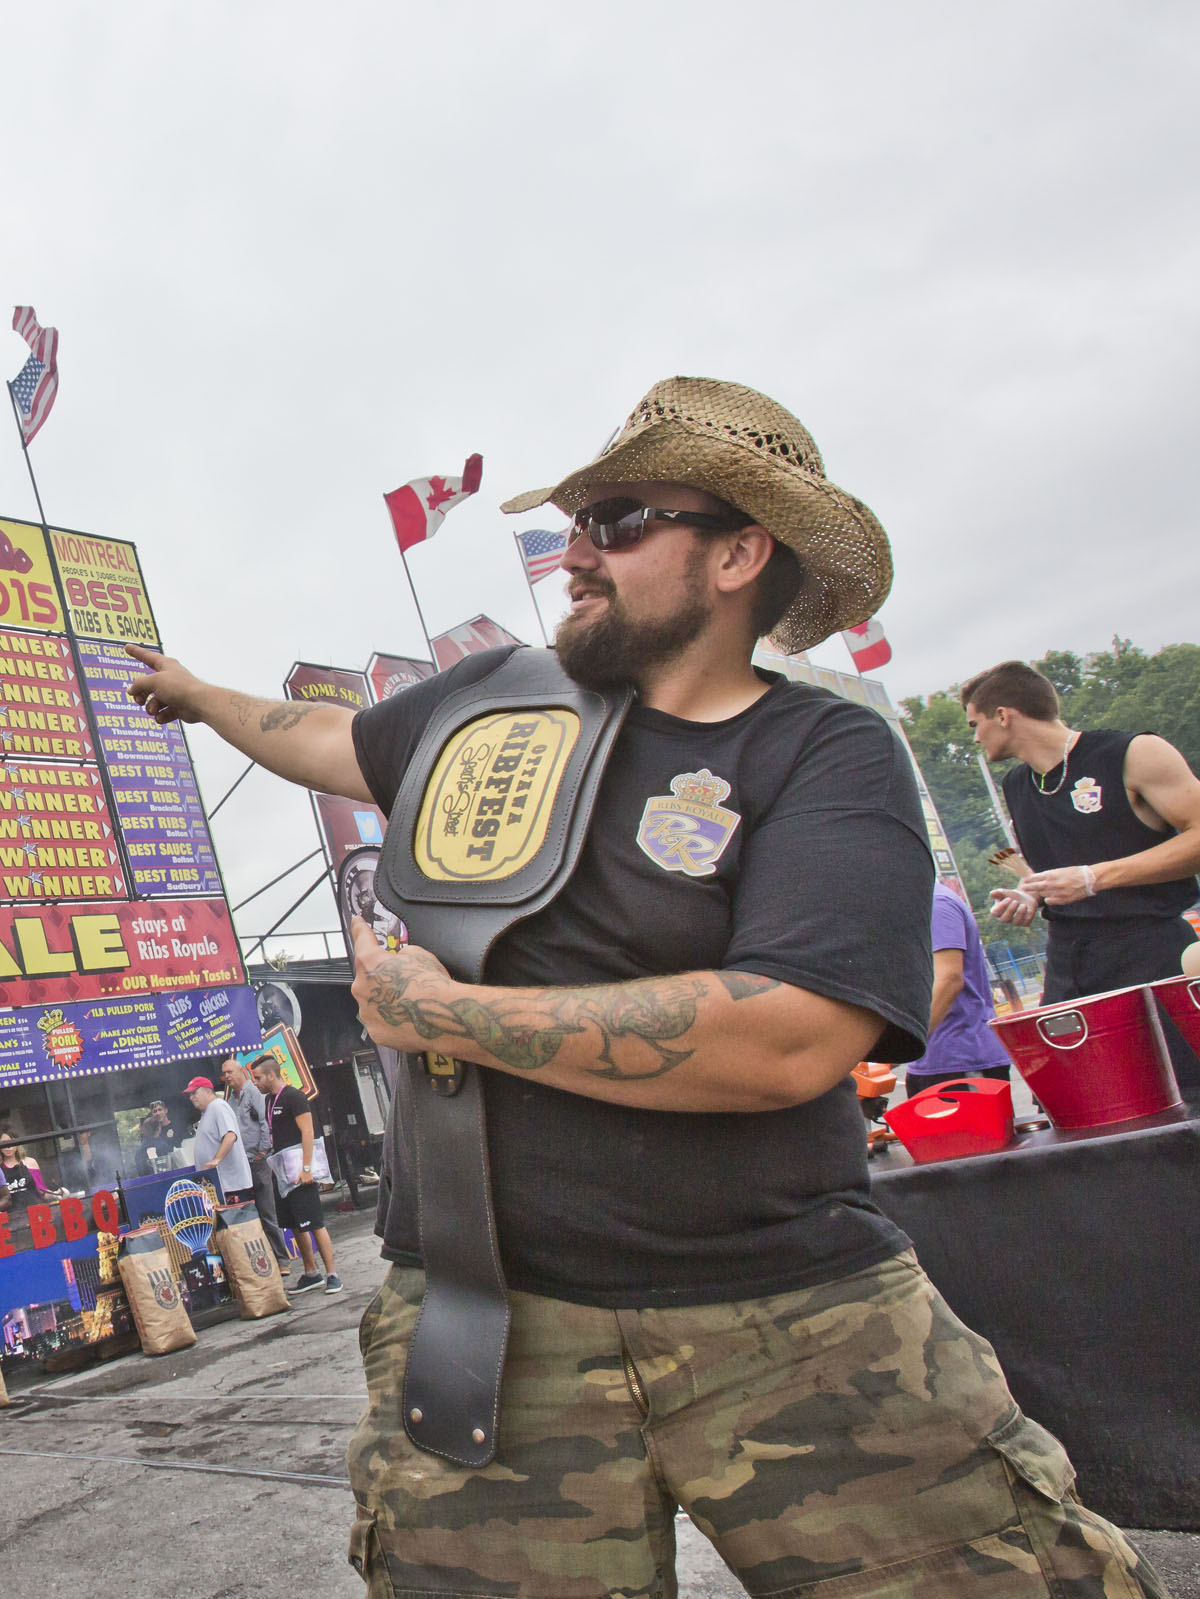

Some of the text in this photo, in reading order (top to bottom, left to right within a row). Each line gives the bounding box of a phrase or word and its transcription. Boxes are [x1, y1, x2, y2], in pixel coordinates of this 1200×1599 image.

[53, 534, 135, 573] MONTREAL
[66, 578, 142, 615] BEST
[74, 609, 154, 640] RIBS & SAUCE
[300, 683, 364, 708] COME SEE
[442, 742, 491, 838] Sparks Street
[466, 720, 540, 862] RIBFEST
[507, 744, 548, 826] OTTAWA
[658, 802, 726, 822] RIBS ROYALE
[135, 869, 199, 883] BEST RIBS
[131, 915, 187, 937] stays at
[137, 935, 218, 960] Ribs Royale
[150, 970, 200, 987] Heavenly
[167, 990, 230, 1018] RIBS CHICKEN
[50, 1034, 79, 1048] PORK
[118, 1032, 161, 1048] DINNER
[27, 1189, 121, 1250] BBQ
